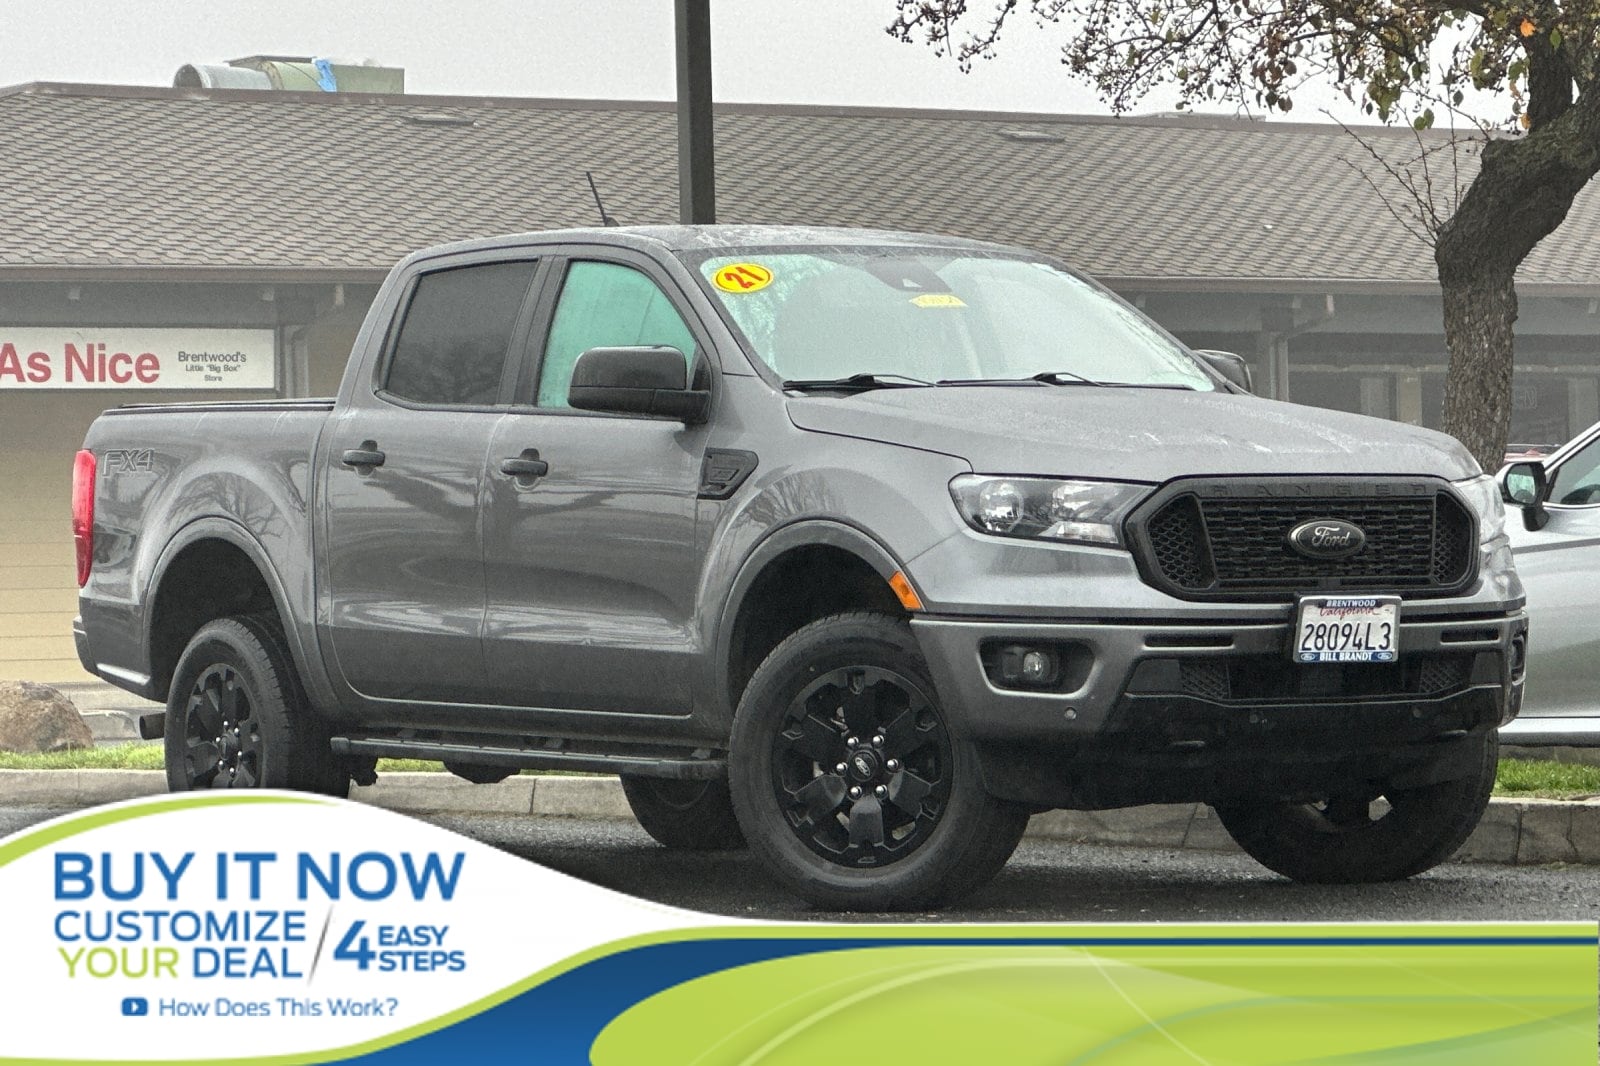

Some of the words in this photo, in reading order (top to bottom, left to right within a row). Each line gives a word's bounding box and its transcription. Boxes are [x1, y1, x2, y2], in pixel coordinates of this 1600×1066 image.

[724, 266, 764, 289] 21
[0, 342, 52, 384] As
[64, 342, 160, 384] Nice
[178, 351, 247, 363] Brentwood's
[185, 364, 204, 372] Little
[102, 448, 155, 478] FX4
[1311, 526, 1351, 547] Ford
[1326, 599, 1377, 607] BRENTWOOD
[1301, 622, 1391, 651] 28094L3
[1320, 652, 1337, 661] BILL
[1339, 652, 1372, 661] BRANDT
